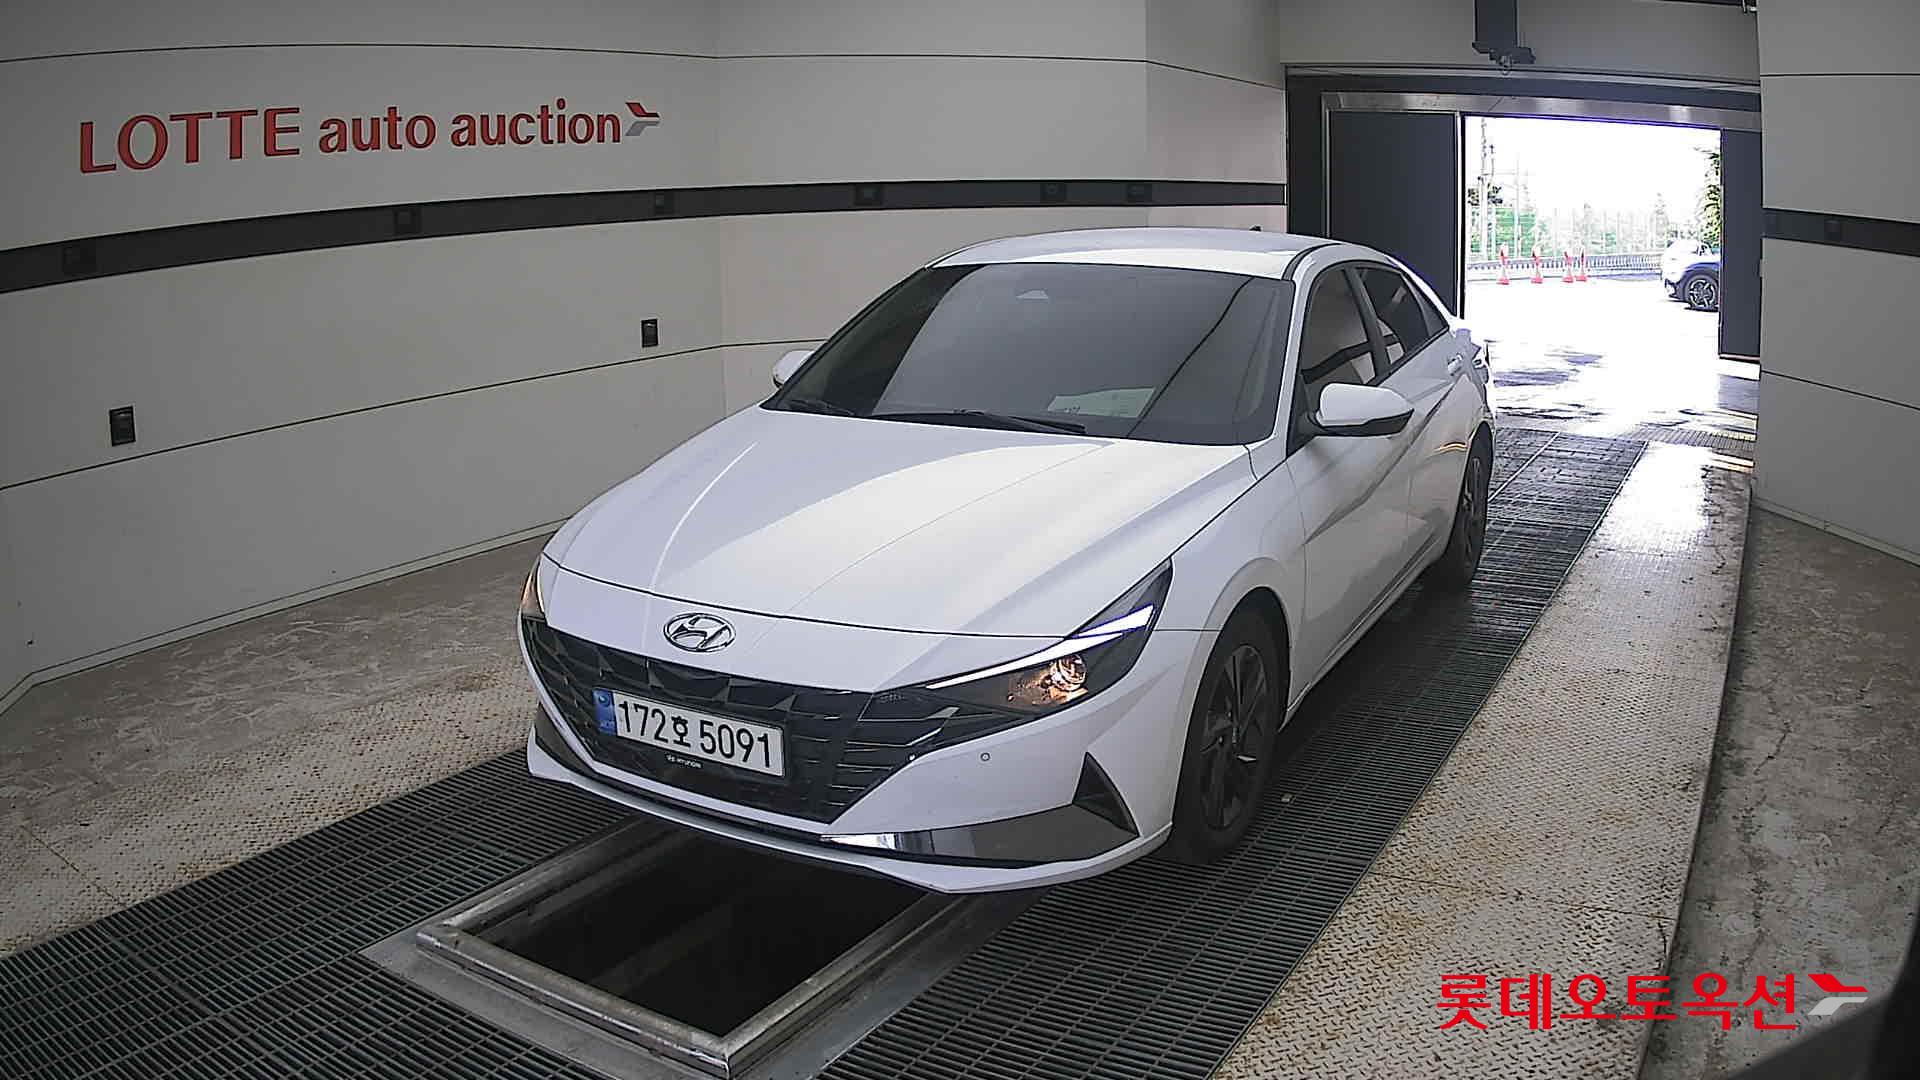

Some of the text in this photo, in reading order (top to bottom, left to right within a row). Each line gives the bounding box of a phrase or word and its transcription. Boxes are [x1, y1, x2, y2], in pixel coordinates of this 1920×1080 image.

[79, 98, 622, 174] LOTTE auto auction
[618, 700, 770, 768] 172호 5091
